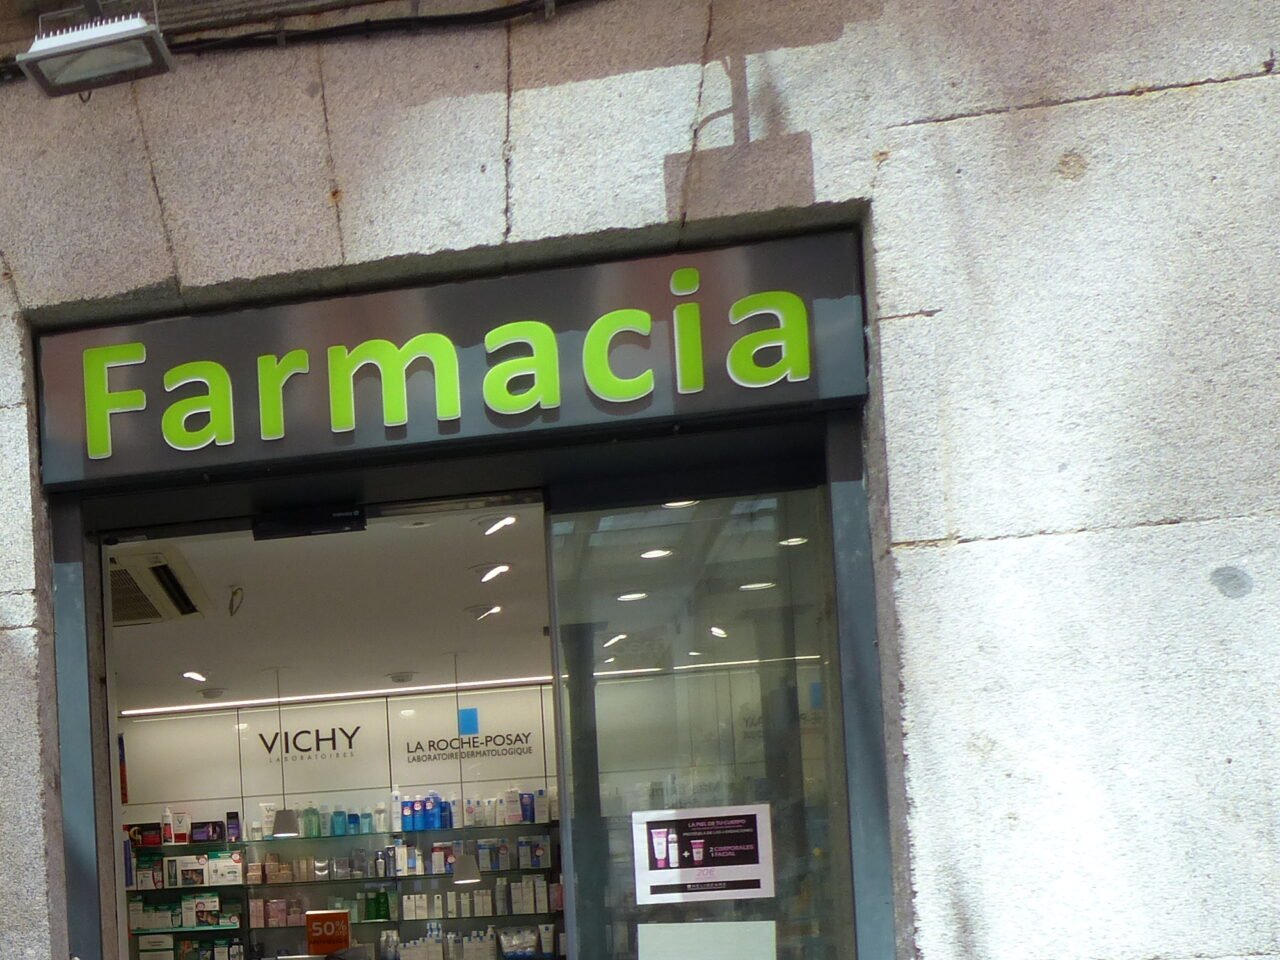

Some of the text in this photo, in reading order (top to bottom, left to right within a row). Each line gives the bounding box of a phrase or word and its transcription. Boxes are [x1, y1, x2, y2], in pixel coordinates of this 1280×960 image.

[82, 267, 813, 460] Farmacia
[259, 726, 361, 755] VICHY
[406, 732, 532, 754] LA ROCHE-POSAY
[269, 751, 355, 763] LABORATOIRES
[407, 746, 533, 763] LABORATOIRE DERMATOLOGIQUE
